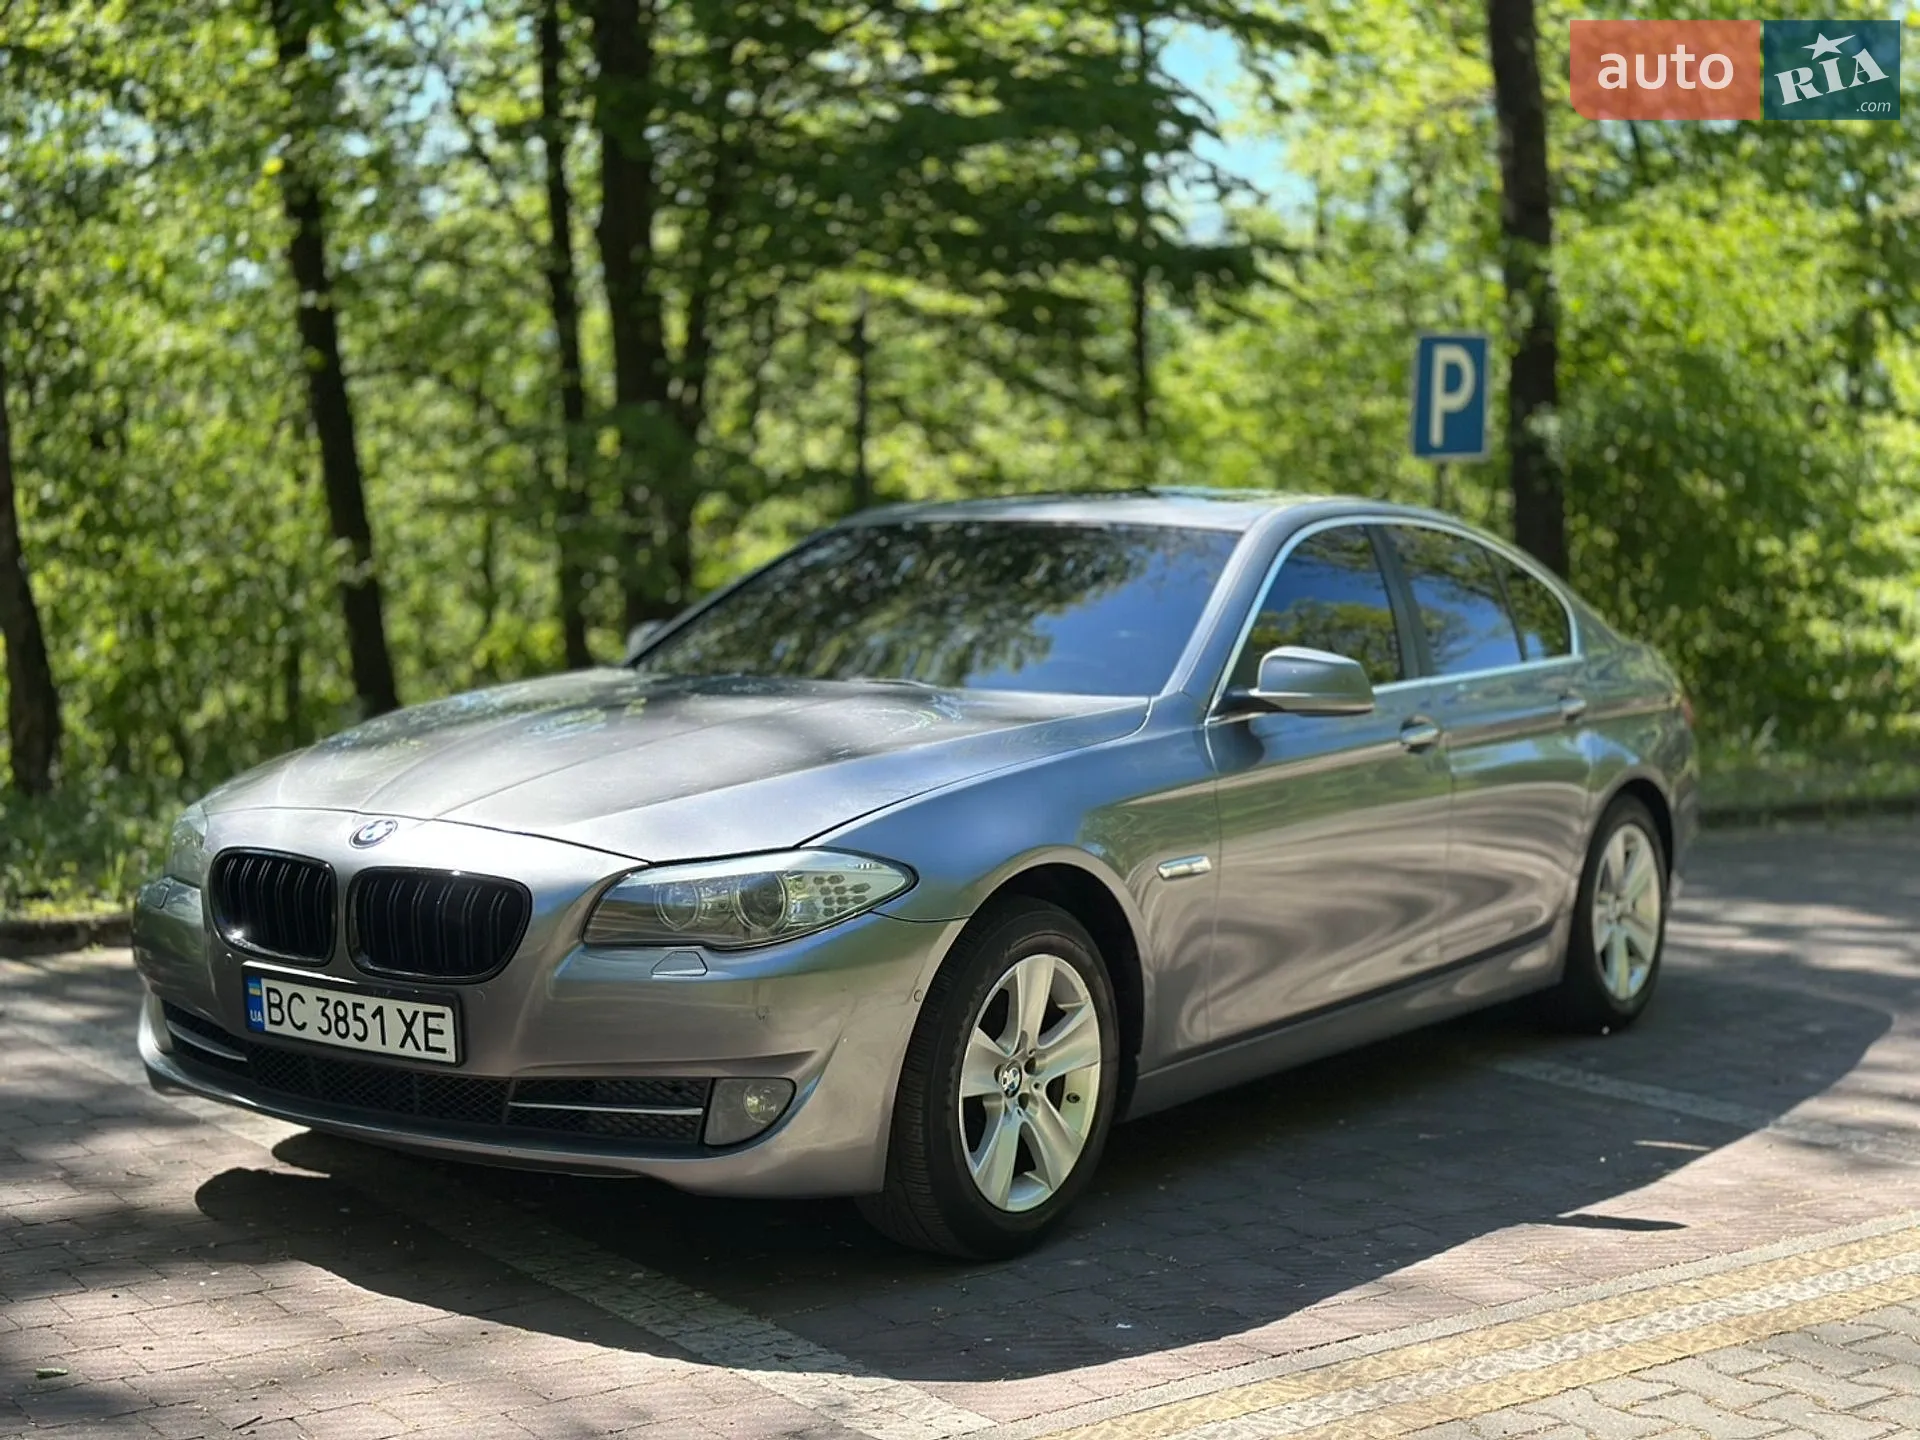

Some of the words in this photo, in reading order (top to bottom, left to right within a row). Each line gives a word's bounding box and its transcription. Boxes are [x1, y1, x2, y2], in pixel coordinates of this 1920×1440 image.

[1428, 344, 1476, 448] P
[250, 1009, 264, 1023] UA
[266, 986, 308, 1031] BC
[315, 996, 387, 1046] 3851
[396, 1008, 448, 1054] XE
